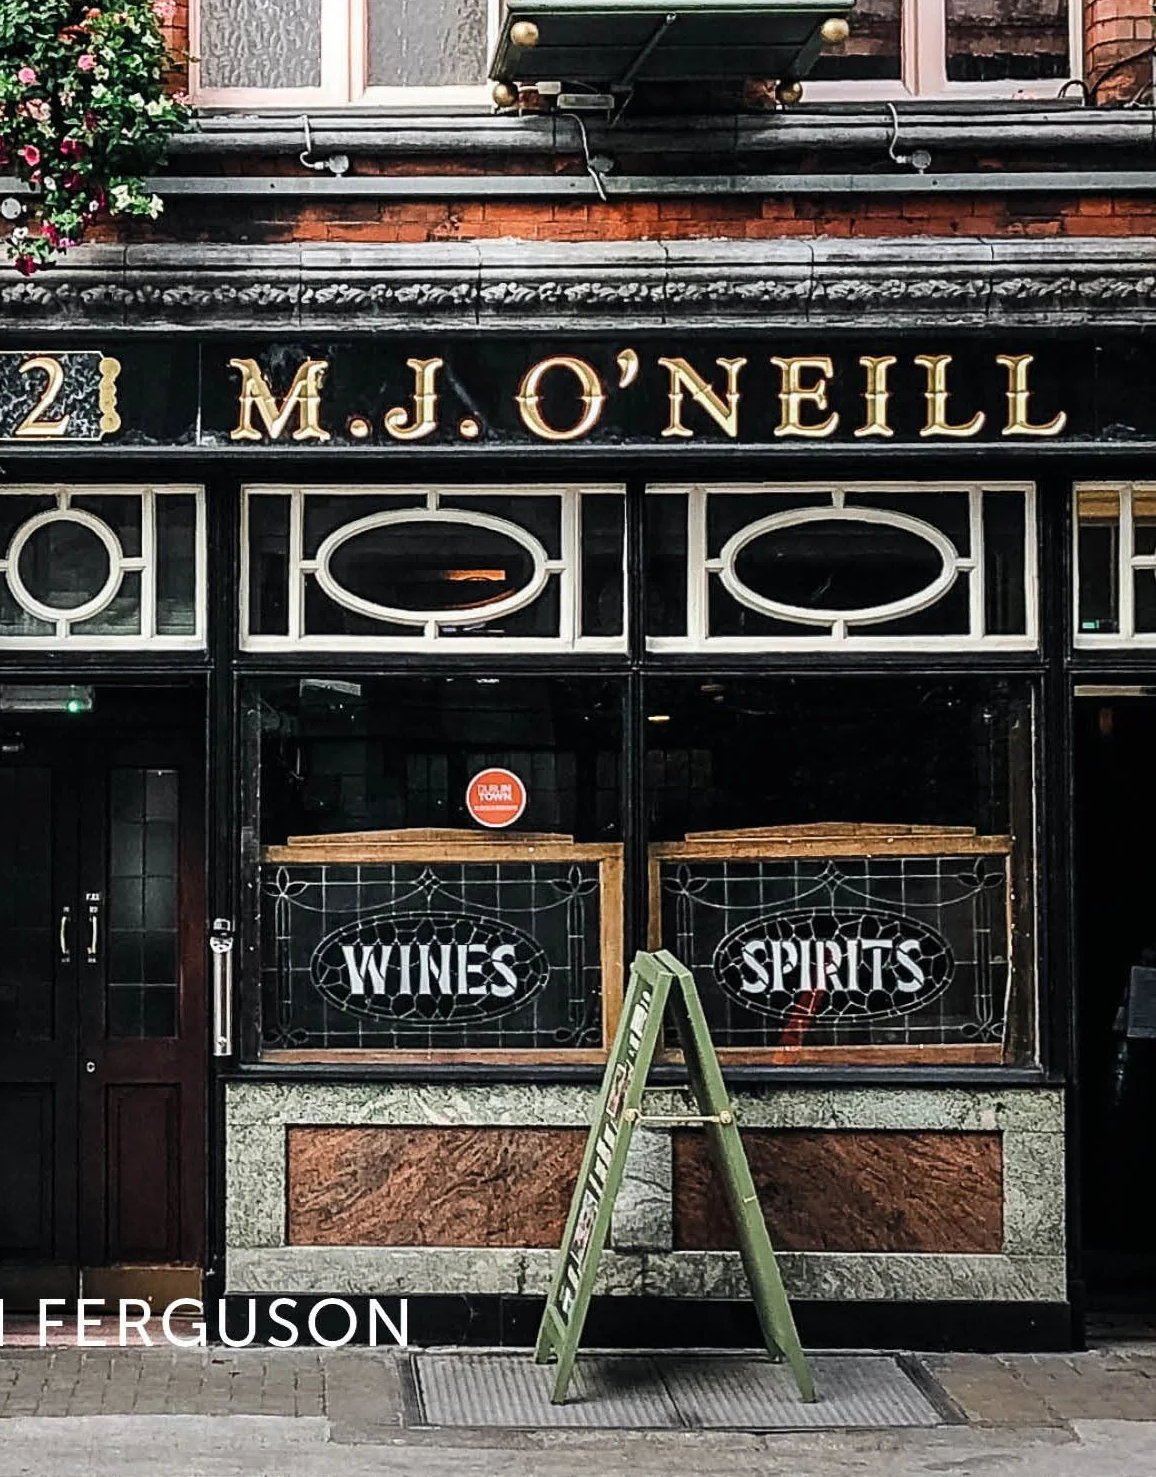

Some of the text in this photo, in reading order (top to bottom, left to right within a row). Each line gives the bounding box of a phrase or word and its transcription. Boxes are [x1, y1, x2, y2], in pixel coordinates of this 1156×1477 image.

[14, 356, 70, 436] 2
[515, 348, 1067, 441] O'NEILL
[478, 793, 513, 802] TOWN
[341, 944, 518, 998] WINES
[741, 939, 925, 994] SPIRITS
